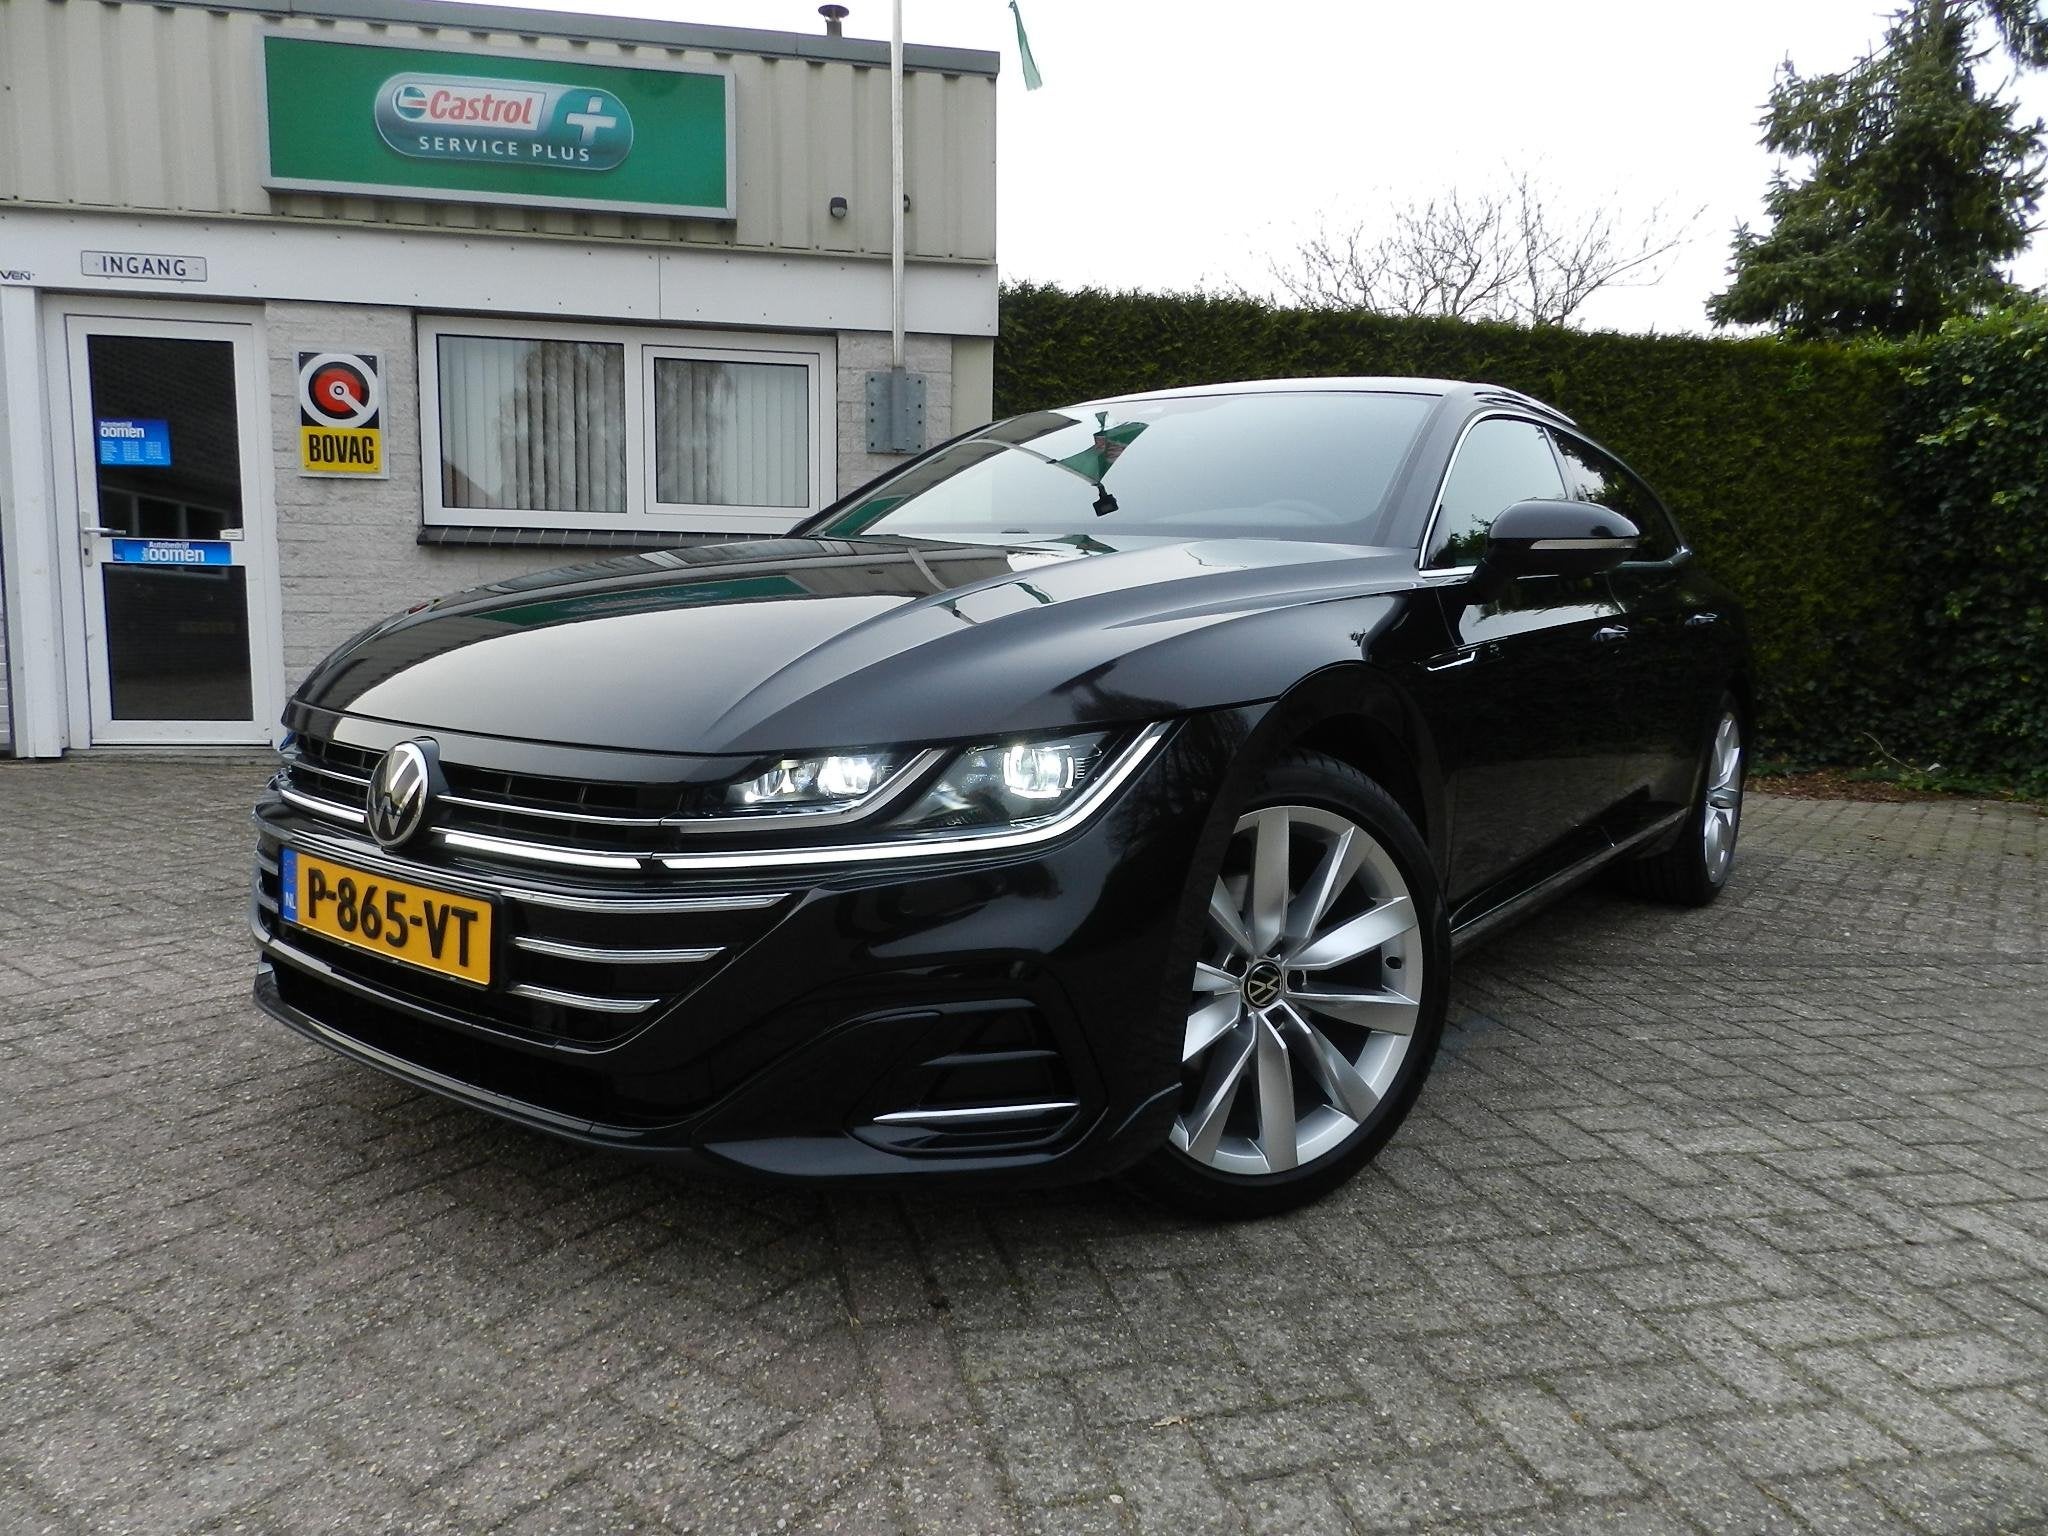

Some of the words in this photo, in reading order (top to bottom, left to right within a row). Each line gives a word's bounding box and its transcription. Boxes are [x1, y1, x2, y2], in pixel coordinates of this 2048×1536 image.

[429, 90, 533, 125] Castrol
[419, 136, 518, 156] SERVICE
[532, 143, 590, 162] PLUS
[102, 255, 187, 276] INGANG
[308, 434, 375, 465] BOVAG
[308, 867, 478, 968] P-865-VT
